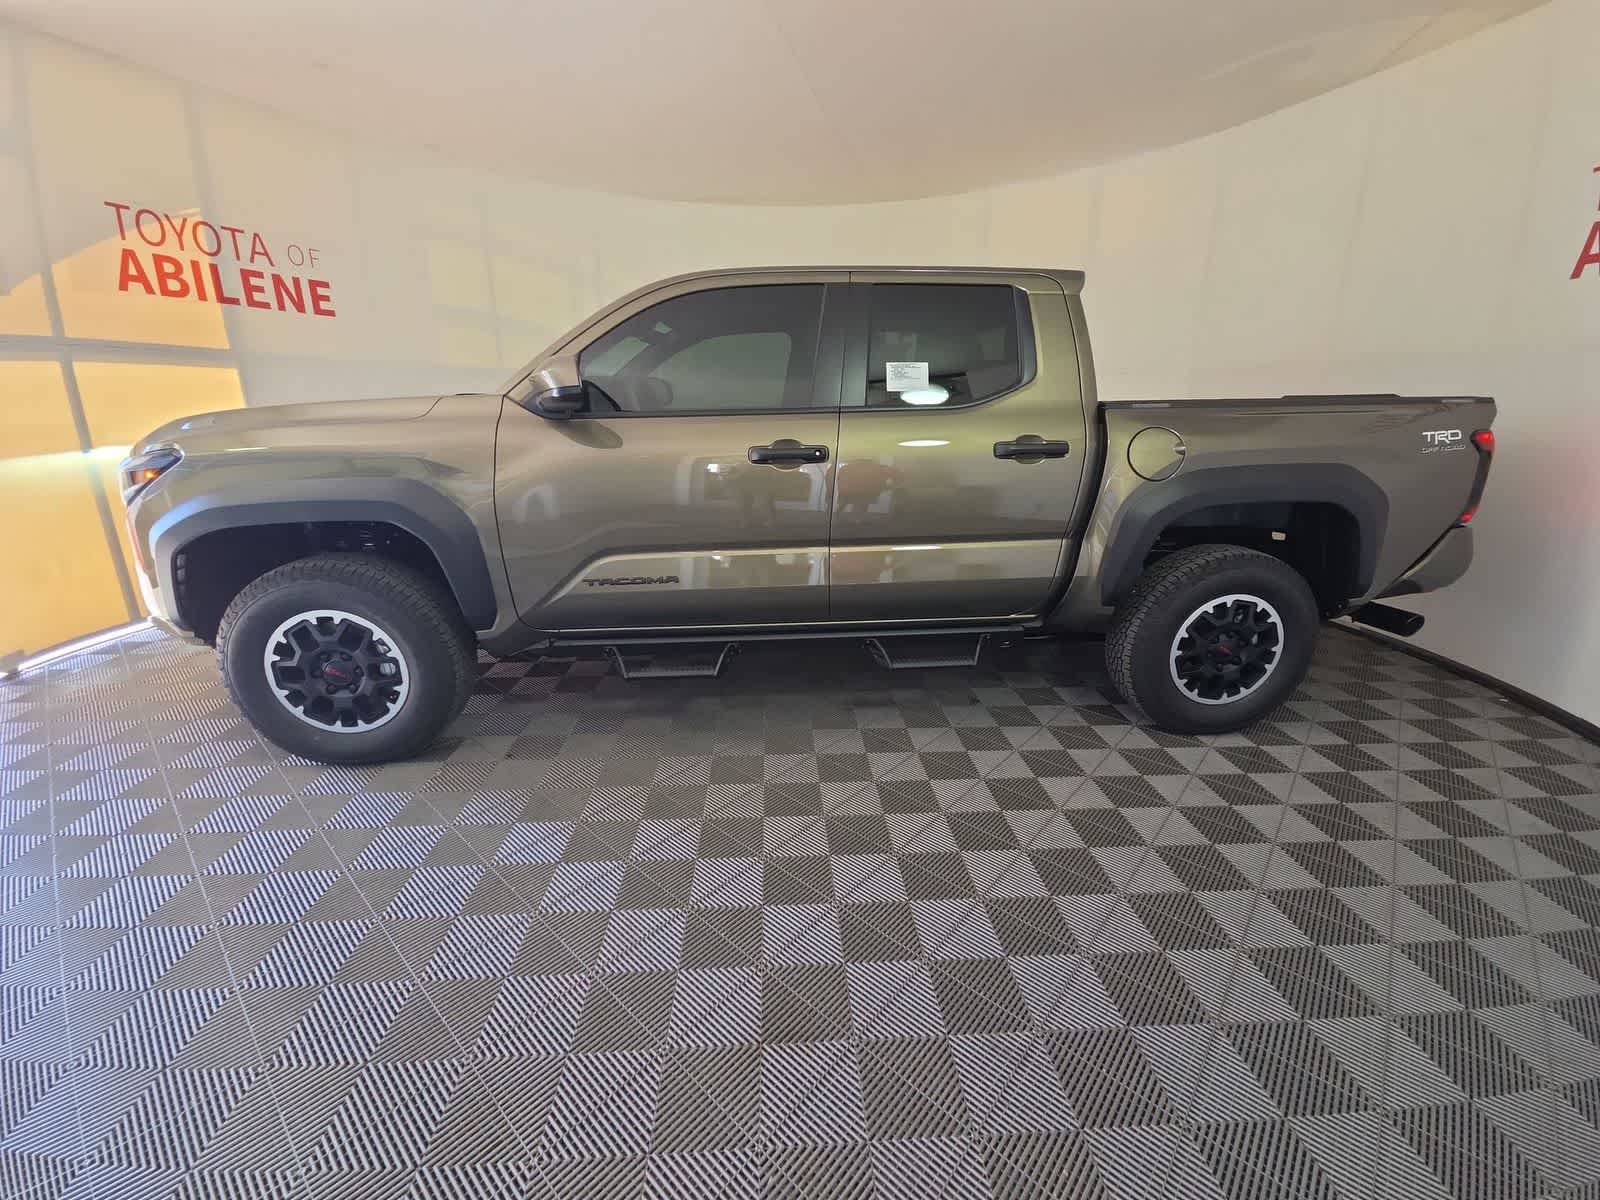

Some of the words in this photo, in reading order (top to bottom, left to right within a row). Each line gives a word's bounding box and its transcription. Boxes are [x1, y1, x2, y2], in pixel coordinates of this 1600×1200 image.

[104, 201, 275, 267] TOYOTA
[287, 244, 321, 269] OF
[118, 247, 336, 318] ABILENE
[1421, 429, 1462, 445] TRD
[582, 575, 680, 587] TACOMA
